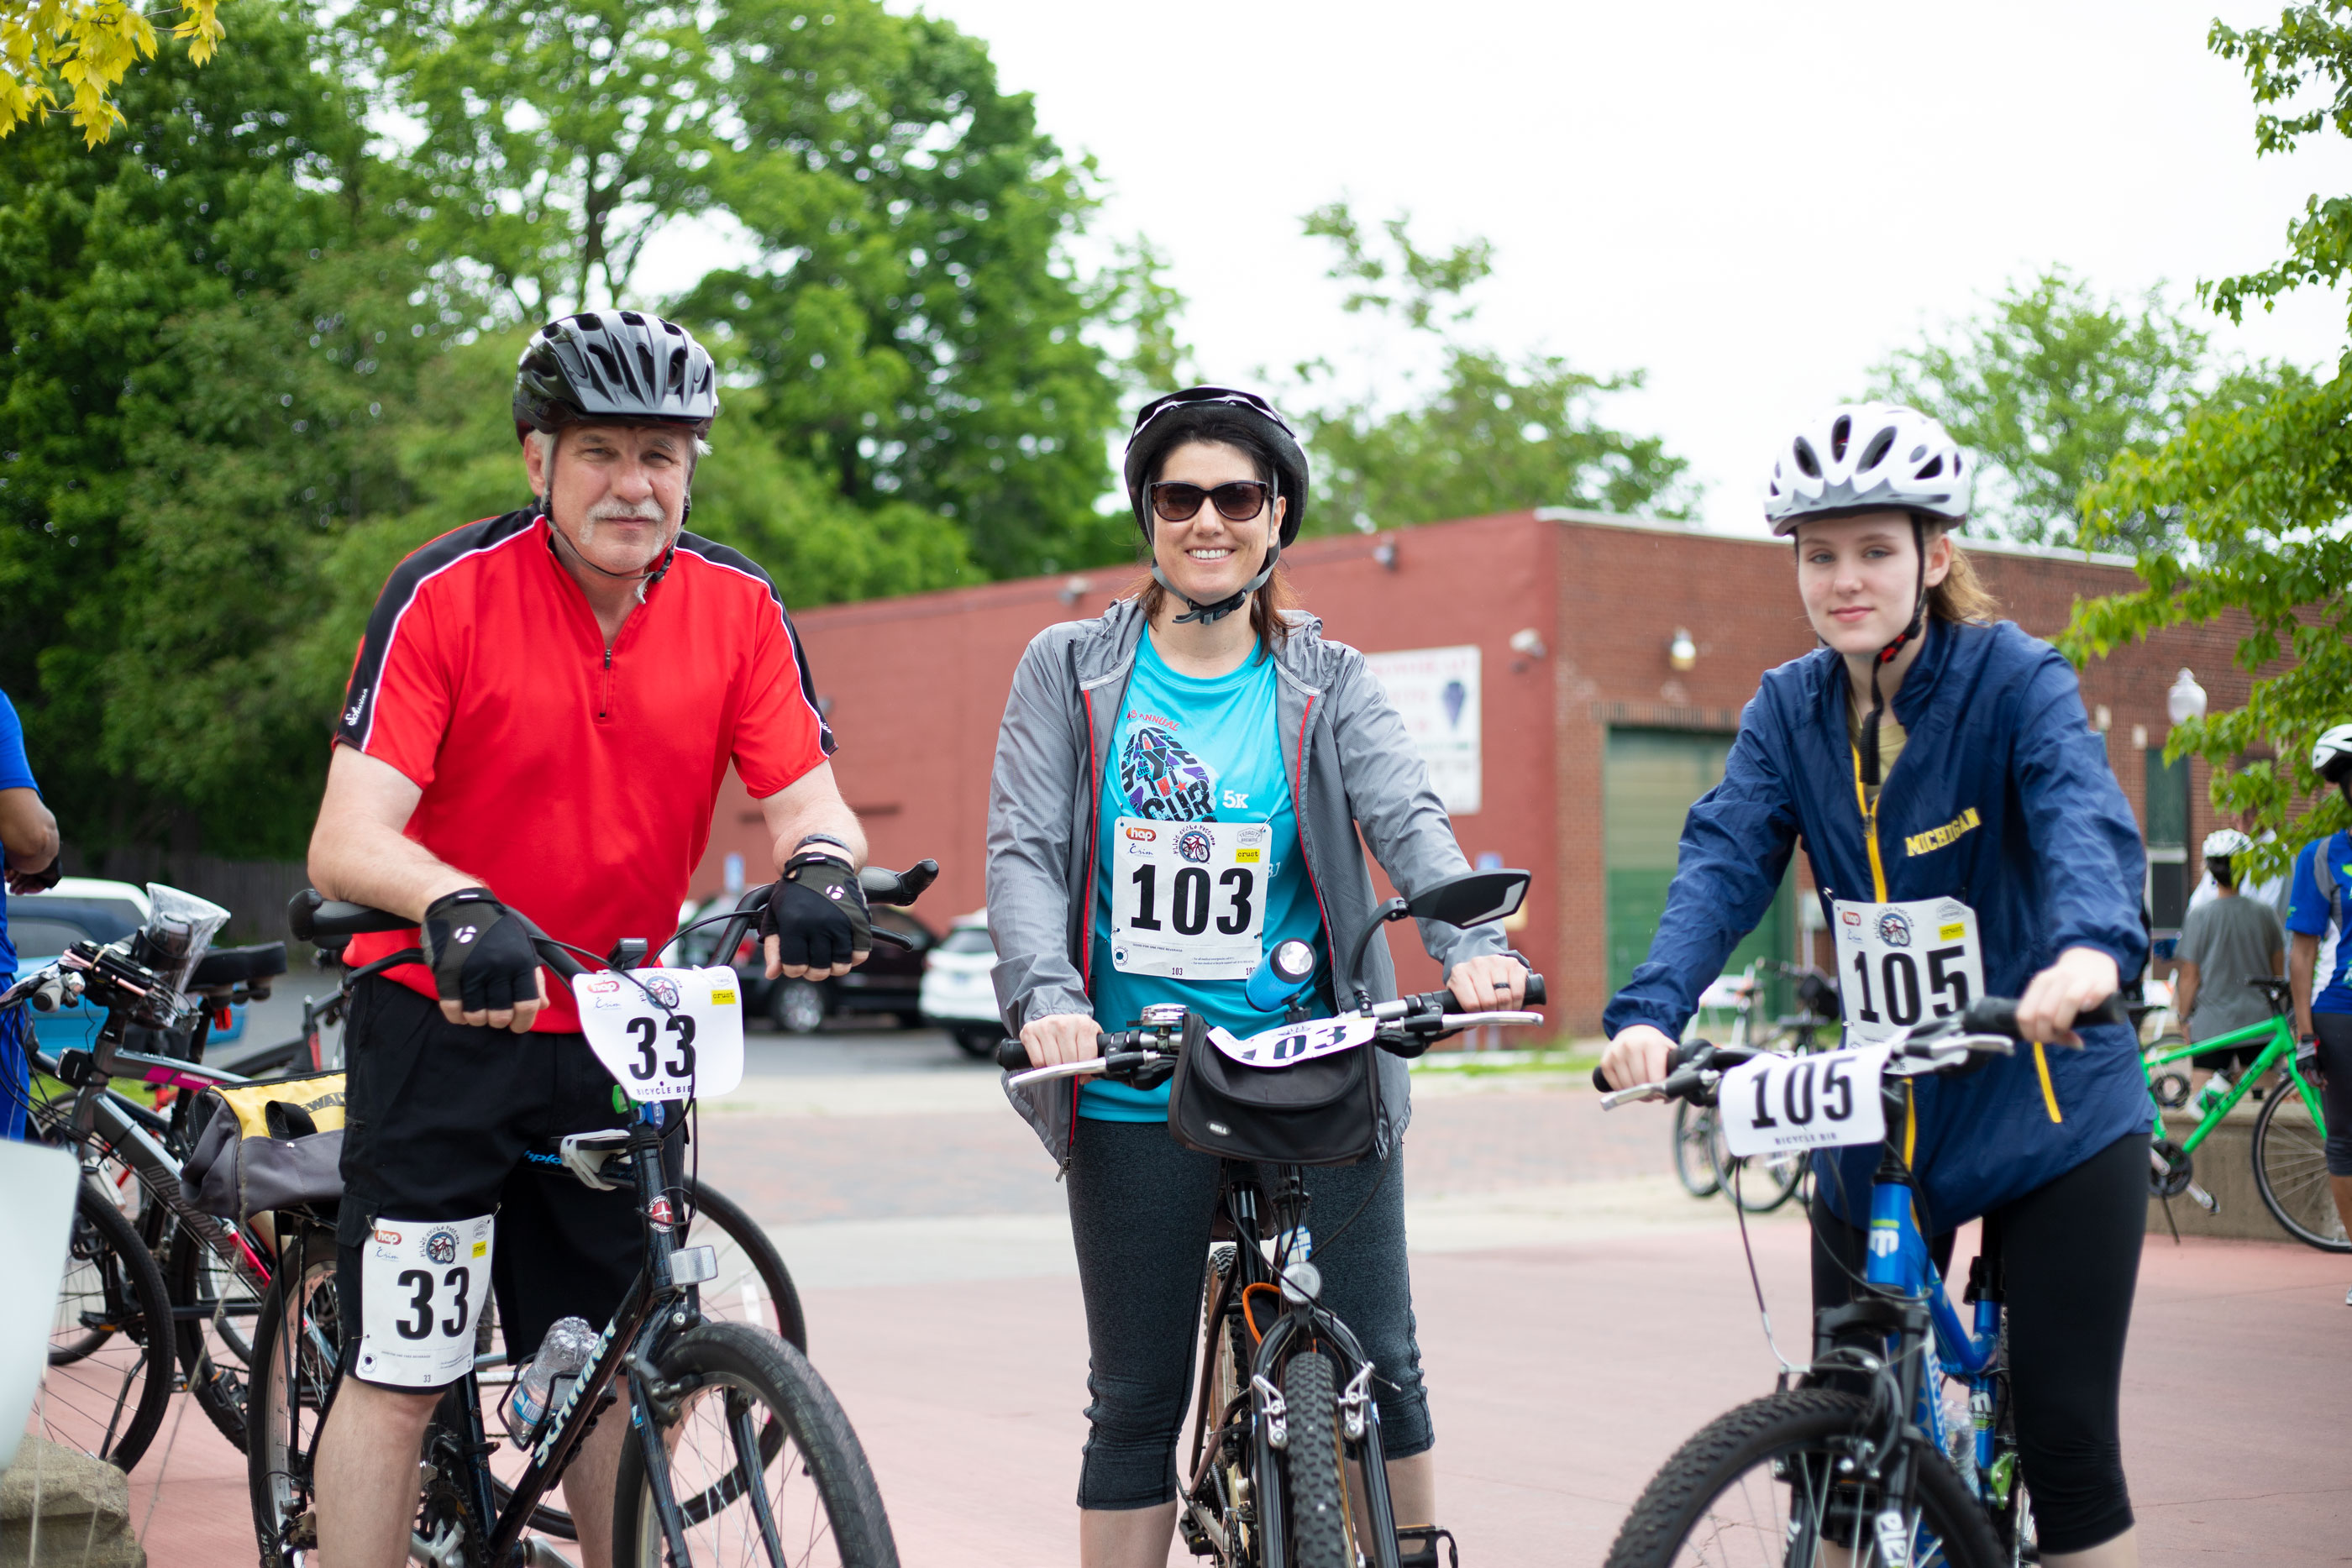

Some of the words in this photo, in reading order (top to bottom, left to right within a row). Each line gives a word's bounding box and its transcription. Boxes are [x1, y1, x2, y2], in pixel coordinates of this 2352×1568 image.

[1137, 766, 1149, 775] the
[1222, 789, 1249, 809] 5K
[1131, 827, 1153, 842] hap
[1904, 807, 1982, 857] MICHIGAN
[1131, 863, 1255, 936] 103
[1941, 926, 1963, 935] crust
[1172, 967, 1183, 976] 103
[1246, 967, 1255, 975] 10
[1854, 945, 1970, 1026] 105
[626, 1015, 696, 1081] 33
[636, 1087, 671, 1095] BICYCLE
[1751, 1056, 1858, 1129] 105
[1210, 1123, 1228, 1135] BELL
[1775, 1134, 1817, 1145] BICYCLE
[1821, 1132, 1837, 1141] BIB
[378, 1230, 399, 1245] hap
[396, 1266, 470, 1340] 33
[423, 1374, 431, 1383] 33
[534, 1316, 617, 1469] SCHWINN
